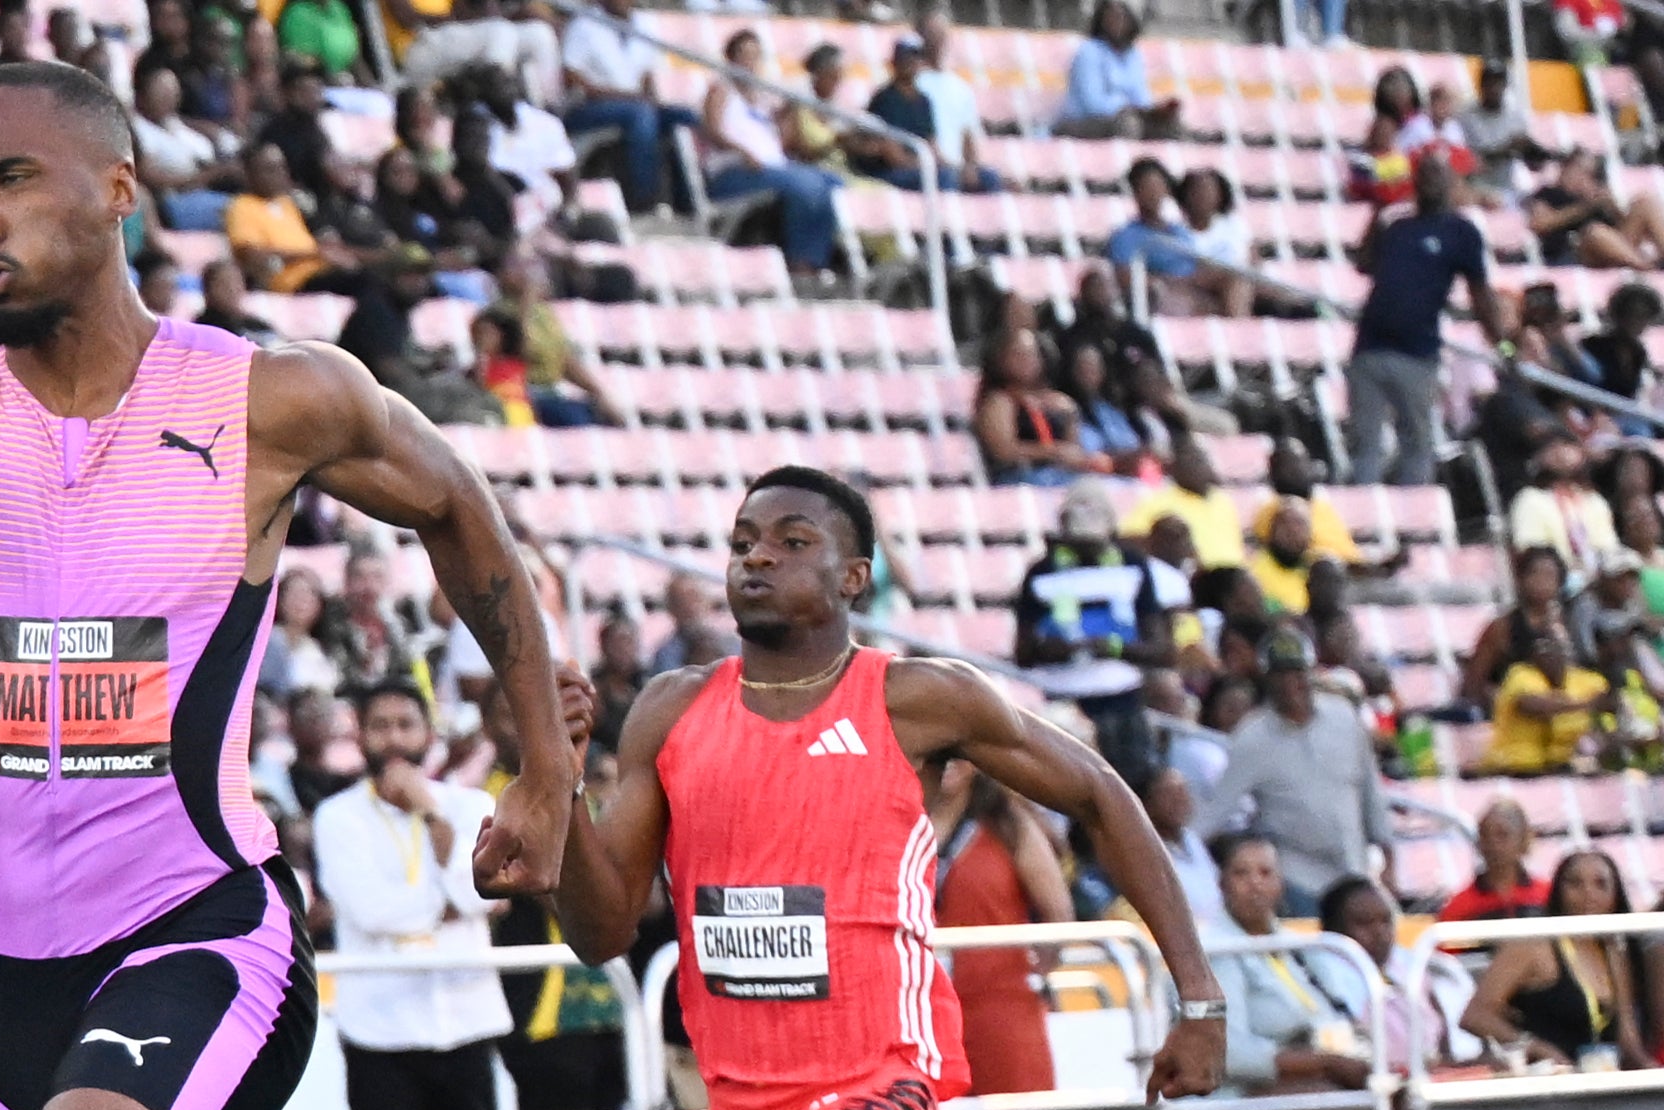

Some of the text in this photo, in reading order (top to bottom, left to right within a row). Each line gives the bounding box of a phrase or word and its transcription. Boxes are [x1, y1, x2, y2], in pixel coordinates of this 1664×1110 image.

[22, 627, 108, 654] KINGSTON
[0, 755, 156, 773] GRAND SLAM TRACK
[703, 925, 813, 959] CHALLENGER
